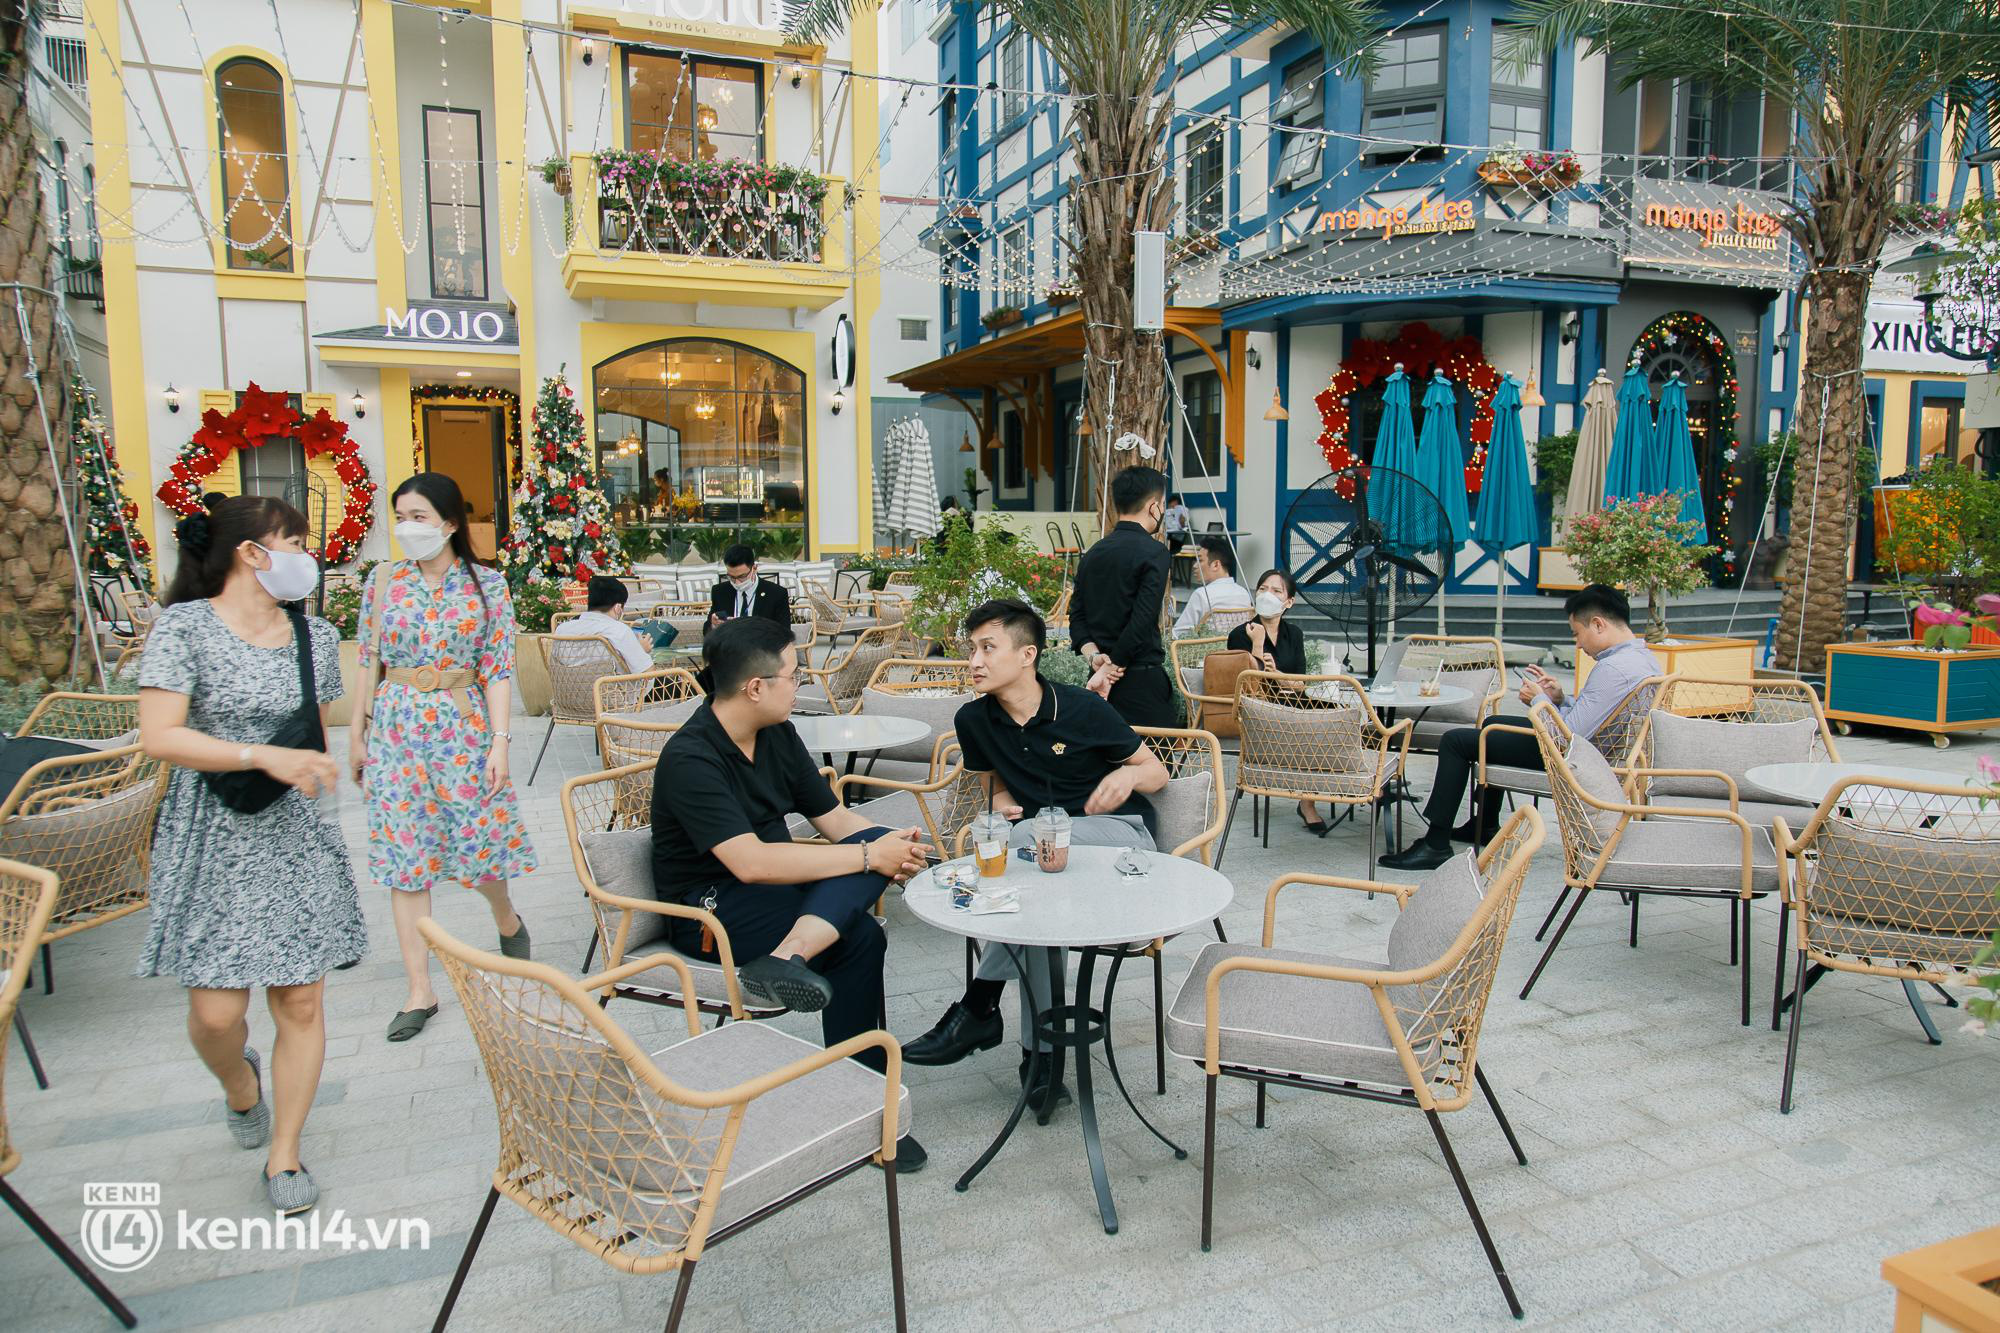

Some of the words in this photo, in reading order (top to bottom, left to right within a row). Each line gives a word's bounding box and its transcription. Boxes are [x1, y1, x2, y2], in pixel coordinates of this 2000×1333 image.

[1320, 208, 1408, 240] mango
[1421, 196, 1473, 223] tree
[1646, 203, 1726, 248] mango
[384, 307, 504, 341] MOJO
